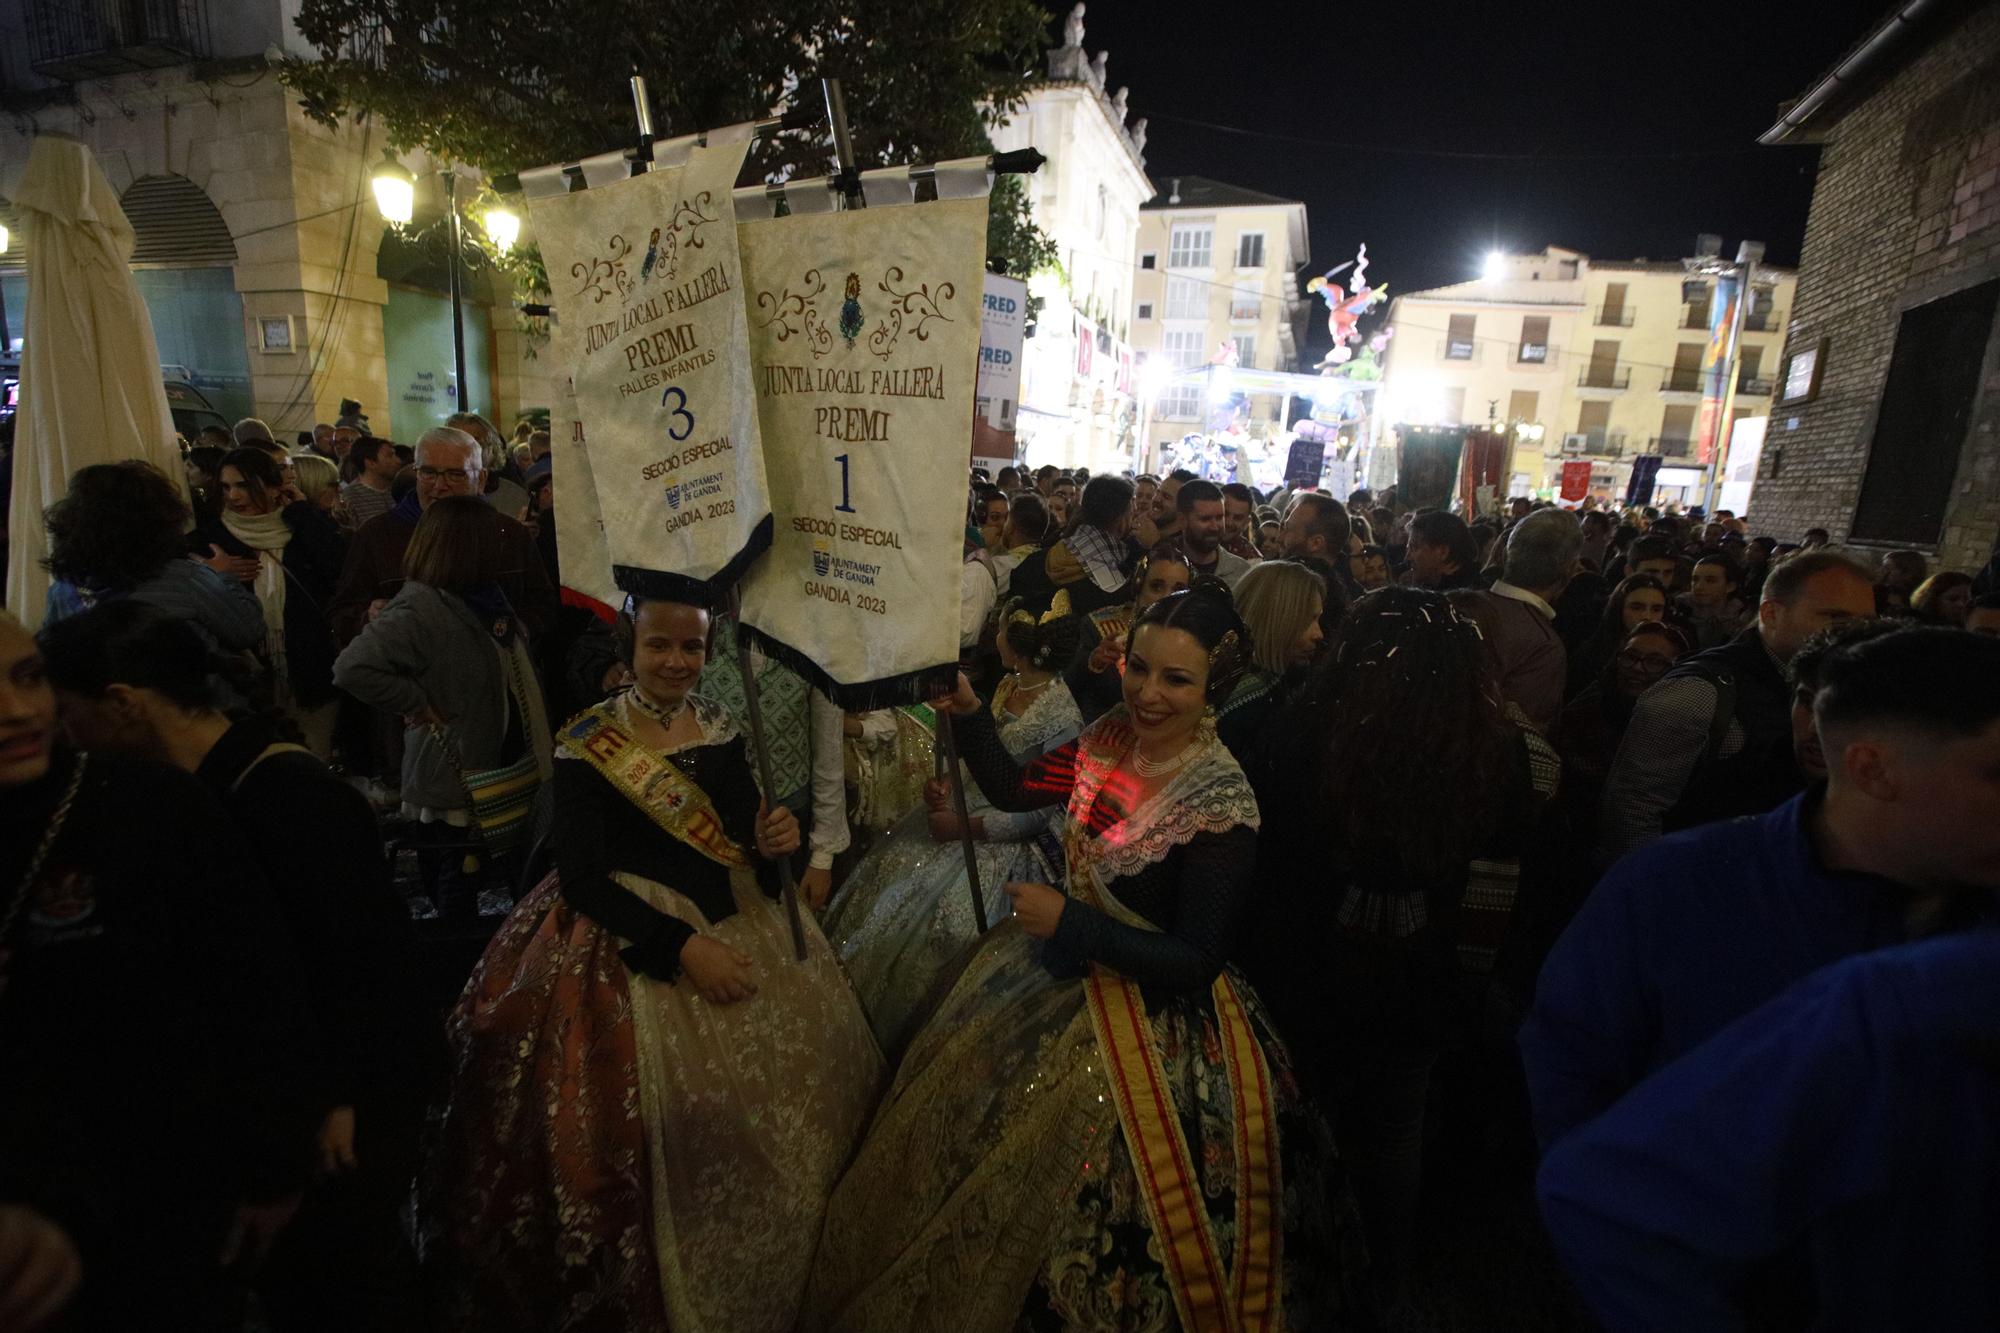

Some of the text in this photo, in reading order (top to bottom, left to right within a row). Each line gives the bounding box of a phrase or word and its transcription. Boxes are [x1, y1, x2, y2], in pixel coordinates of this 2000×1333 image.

[622, 298, 663, 333] LOCAL
[662, 261, 731, 314] FALLERA
[982, 293, 1016, 314] FRED
[623, 323, 699, 372] PREMI
[619, 349, 717, 398] FALLES INFANTILS
[763, 363, 946, 400] JUNTA LOCAL FALLERA
[662, 386, 695, 441] 3
[814, 406, 891, 442] PREMI
[682, 435, 733, 466] ESPECIAL
[680, 472, 724, 495] AJUNTAMENT
[684, 484, 722, 502] DE GANDIA
[834, 453, 856, 513] 1
[665, 499, 736, 534] GANDIA 2023
[792, 517, 903, 550] SECCIÓ ESPECIAL
[830, 557, 882, 576] AJUNTAMENT
[833, 568, 875, 587] DE GANDIA
[804, 581, 887, 615] GANDIA 2023
[626, 759, 650, 785] 2023
